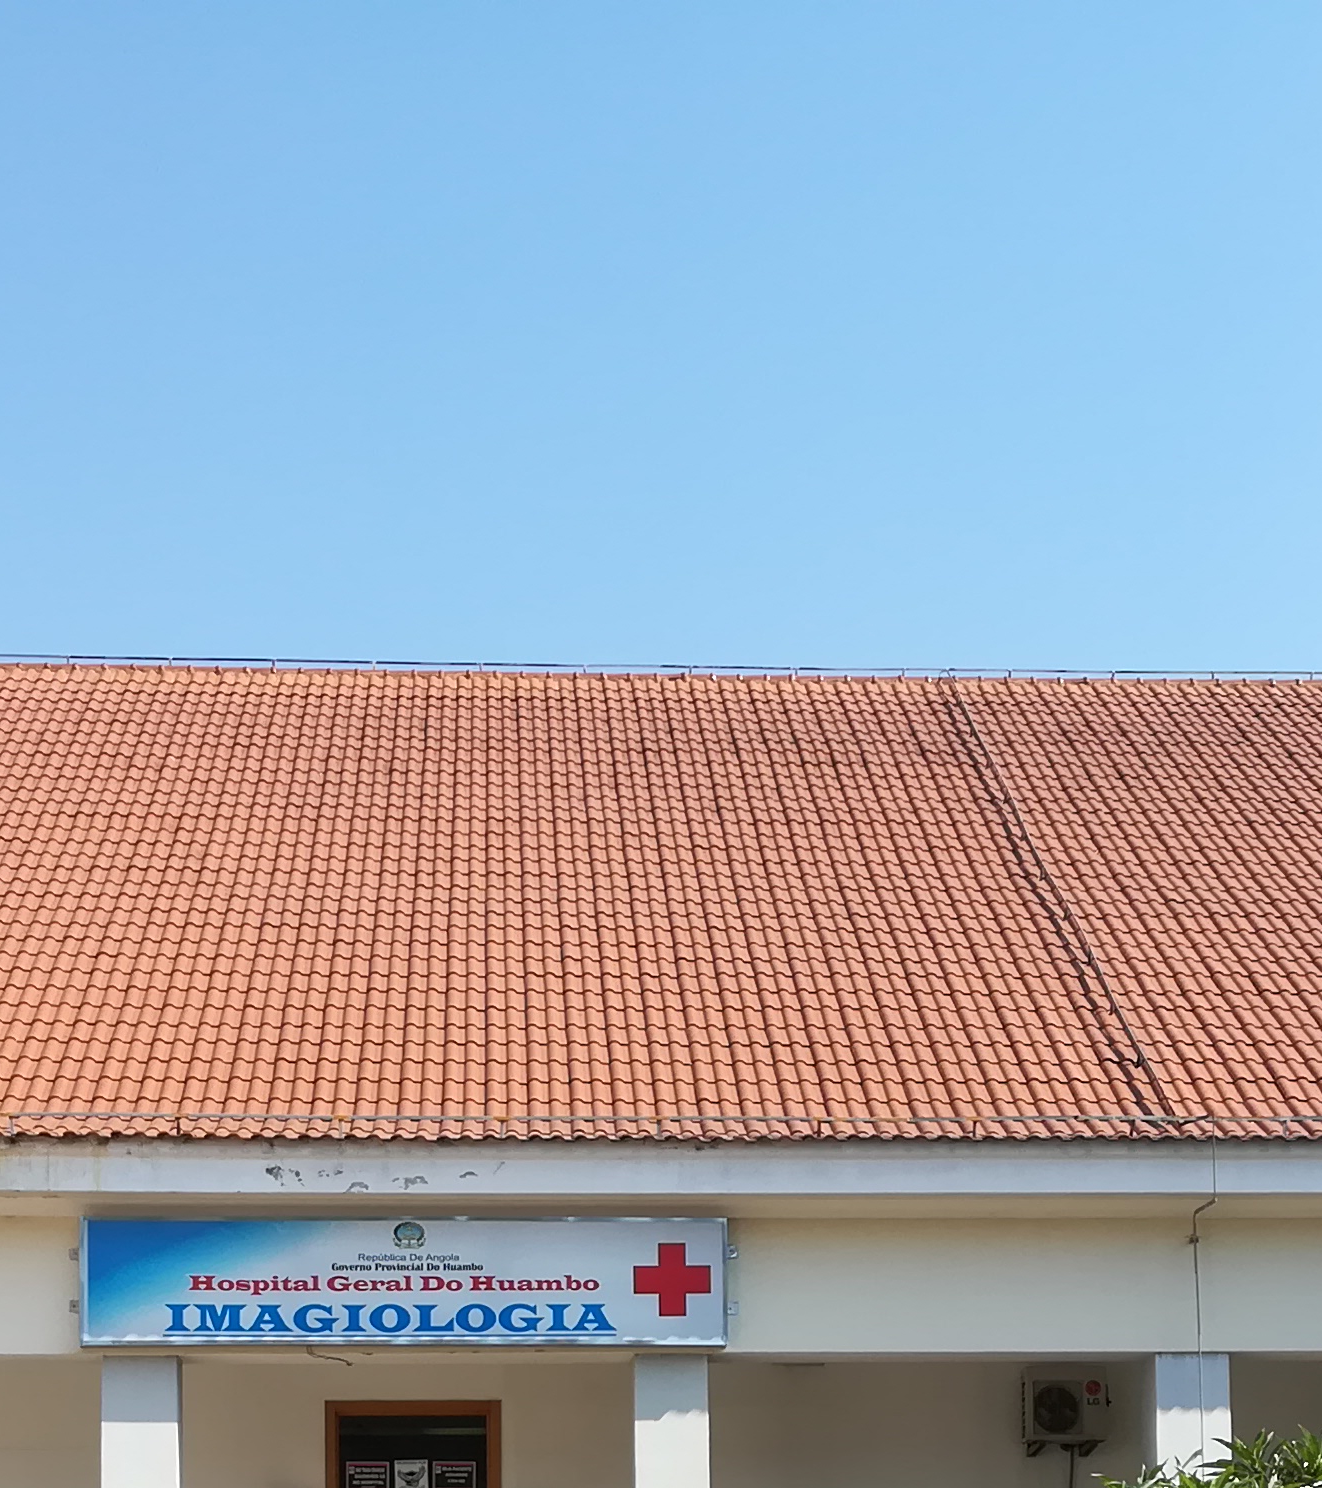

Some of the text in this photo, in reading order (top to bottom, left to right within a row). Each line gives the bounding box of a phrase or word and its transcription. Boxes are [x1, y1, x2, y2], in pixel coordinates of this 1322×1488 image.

[358, 1253, 460, 1263] República De Angola
[331, 1263, 484, 1271] Governo Provincial Do Huambo
[189, 1275, 600, 1296] Hospital Geral Do Huambo
[164, 1303, 617, 1332] IMAGIOLOGIA
[1087, 1397, 1100, 1405] LG
